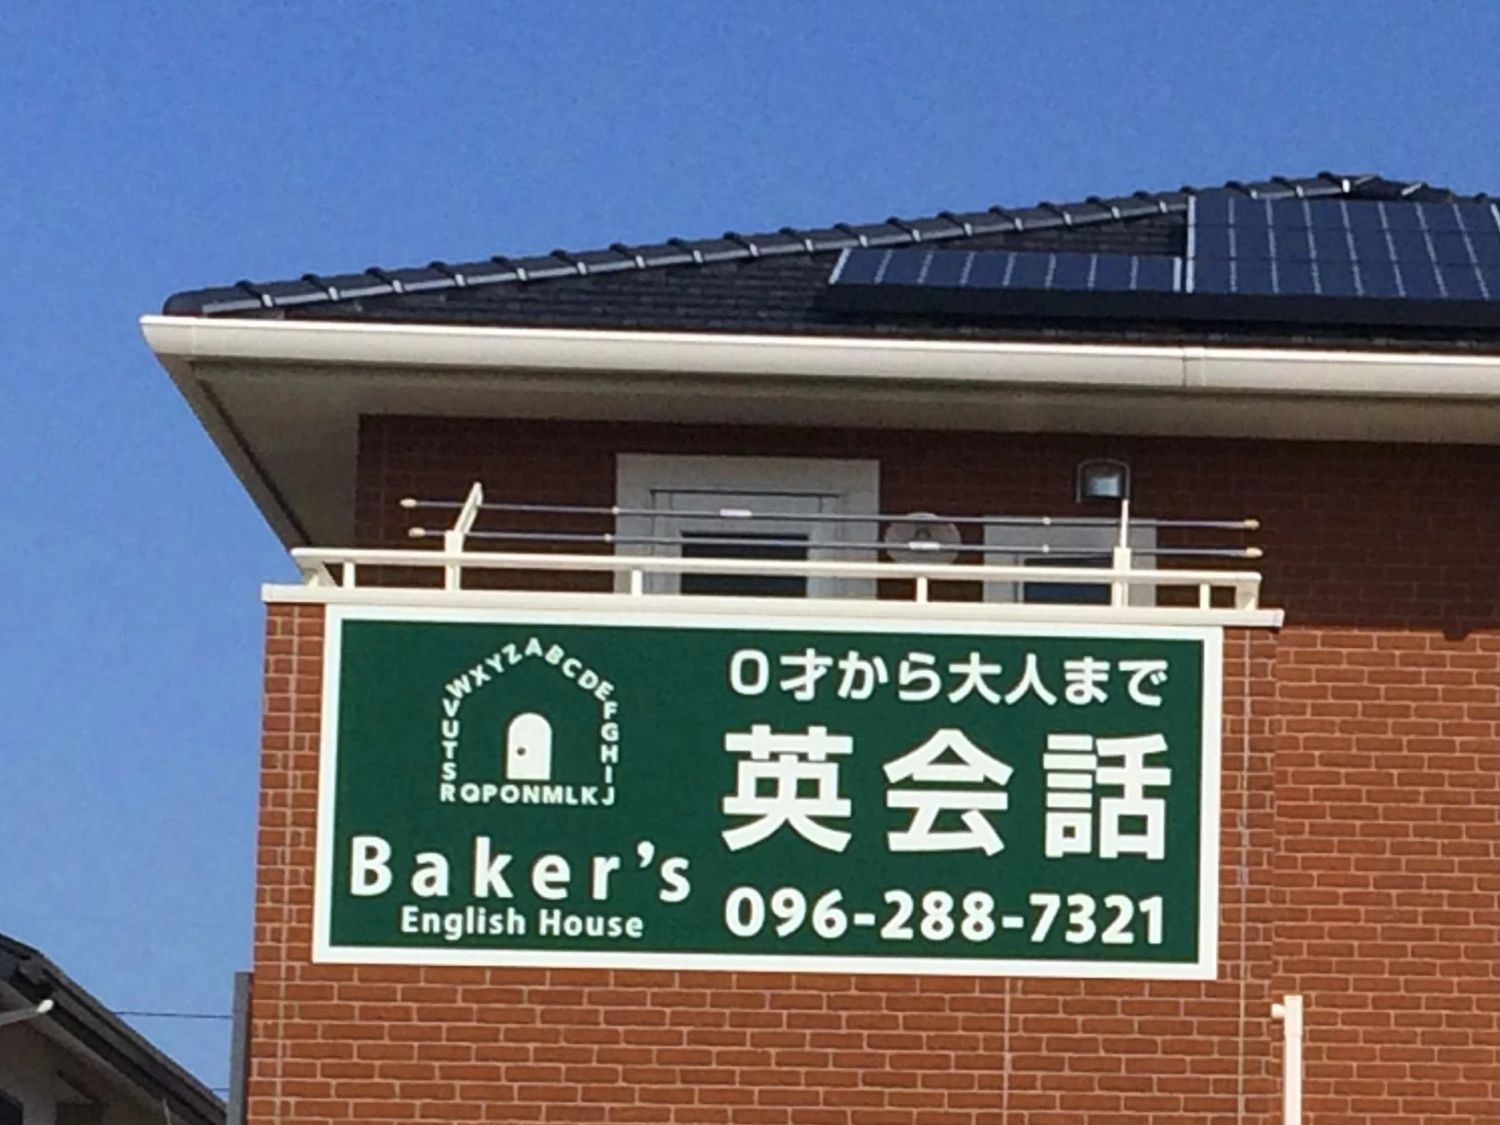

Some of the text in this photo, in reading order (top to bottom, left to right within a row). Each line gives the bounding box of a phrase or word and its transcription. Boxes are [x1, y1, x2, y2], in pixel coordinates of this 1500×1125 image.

[721, 723, 1172, 860] 英会話
[400, 905, 644, 941] English House
[723, 886, 1164, 946] 096-288-7321
